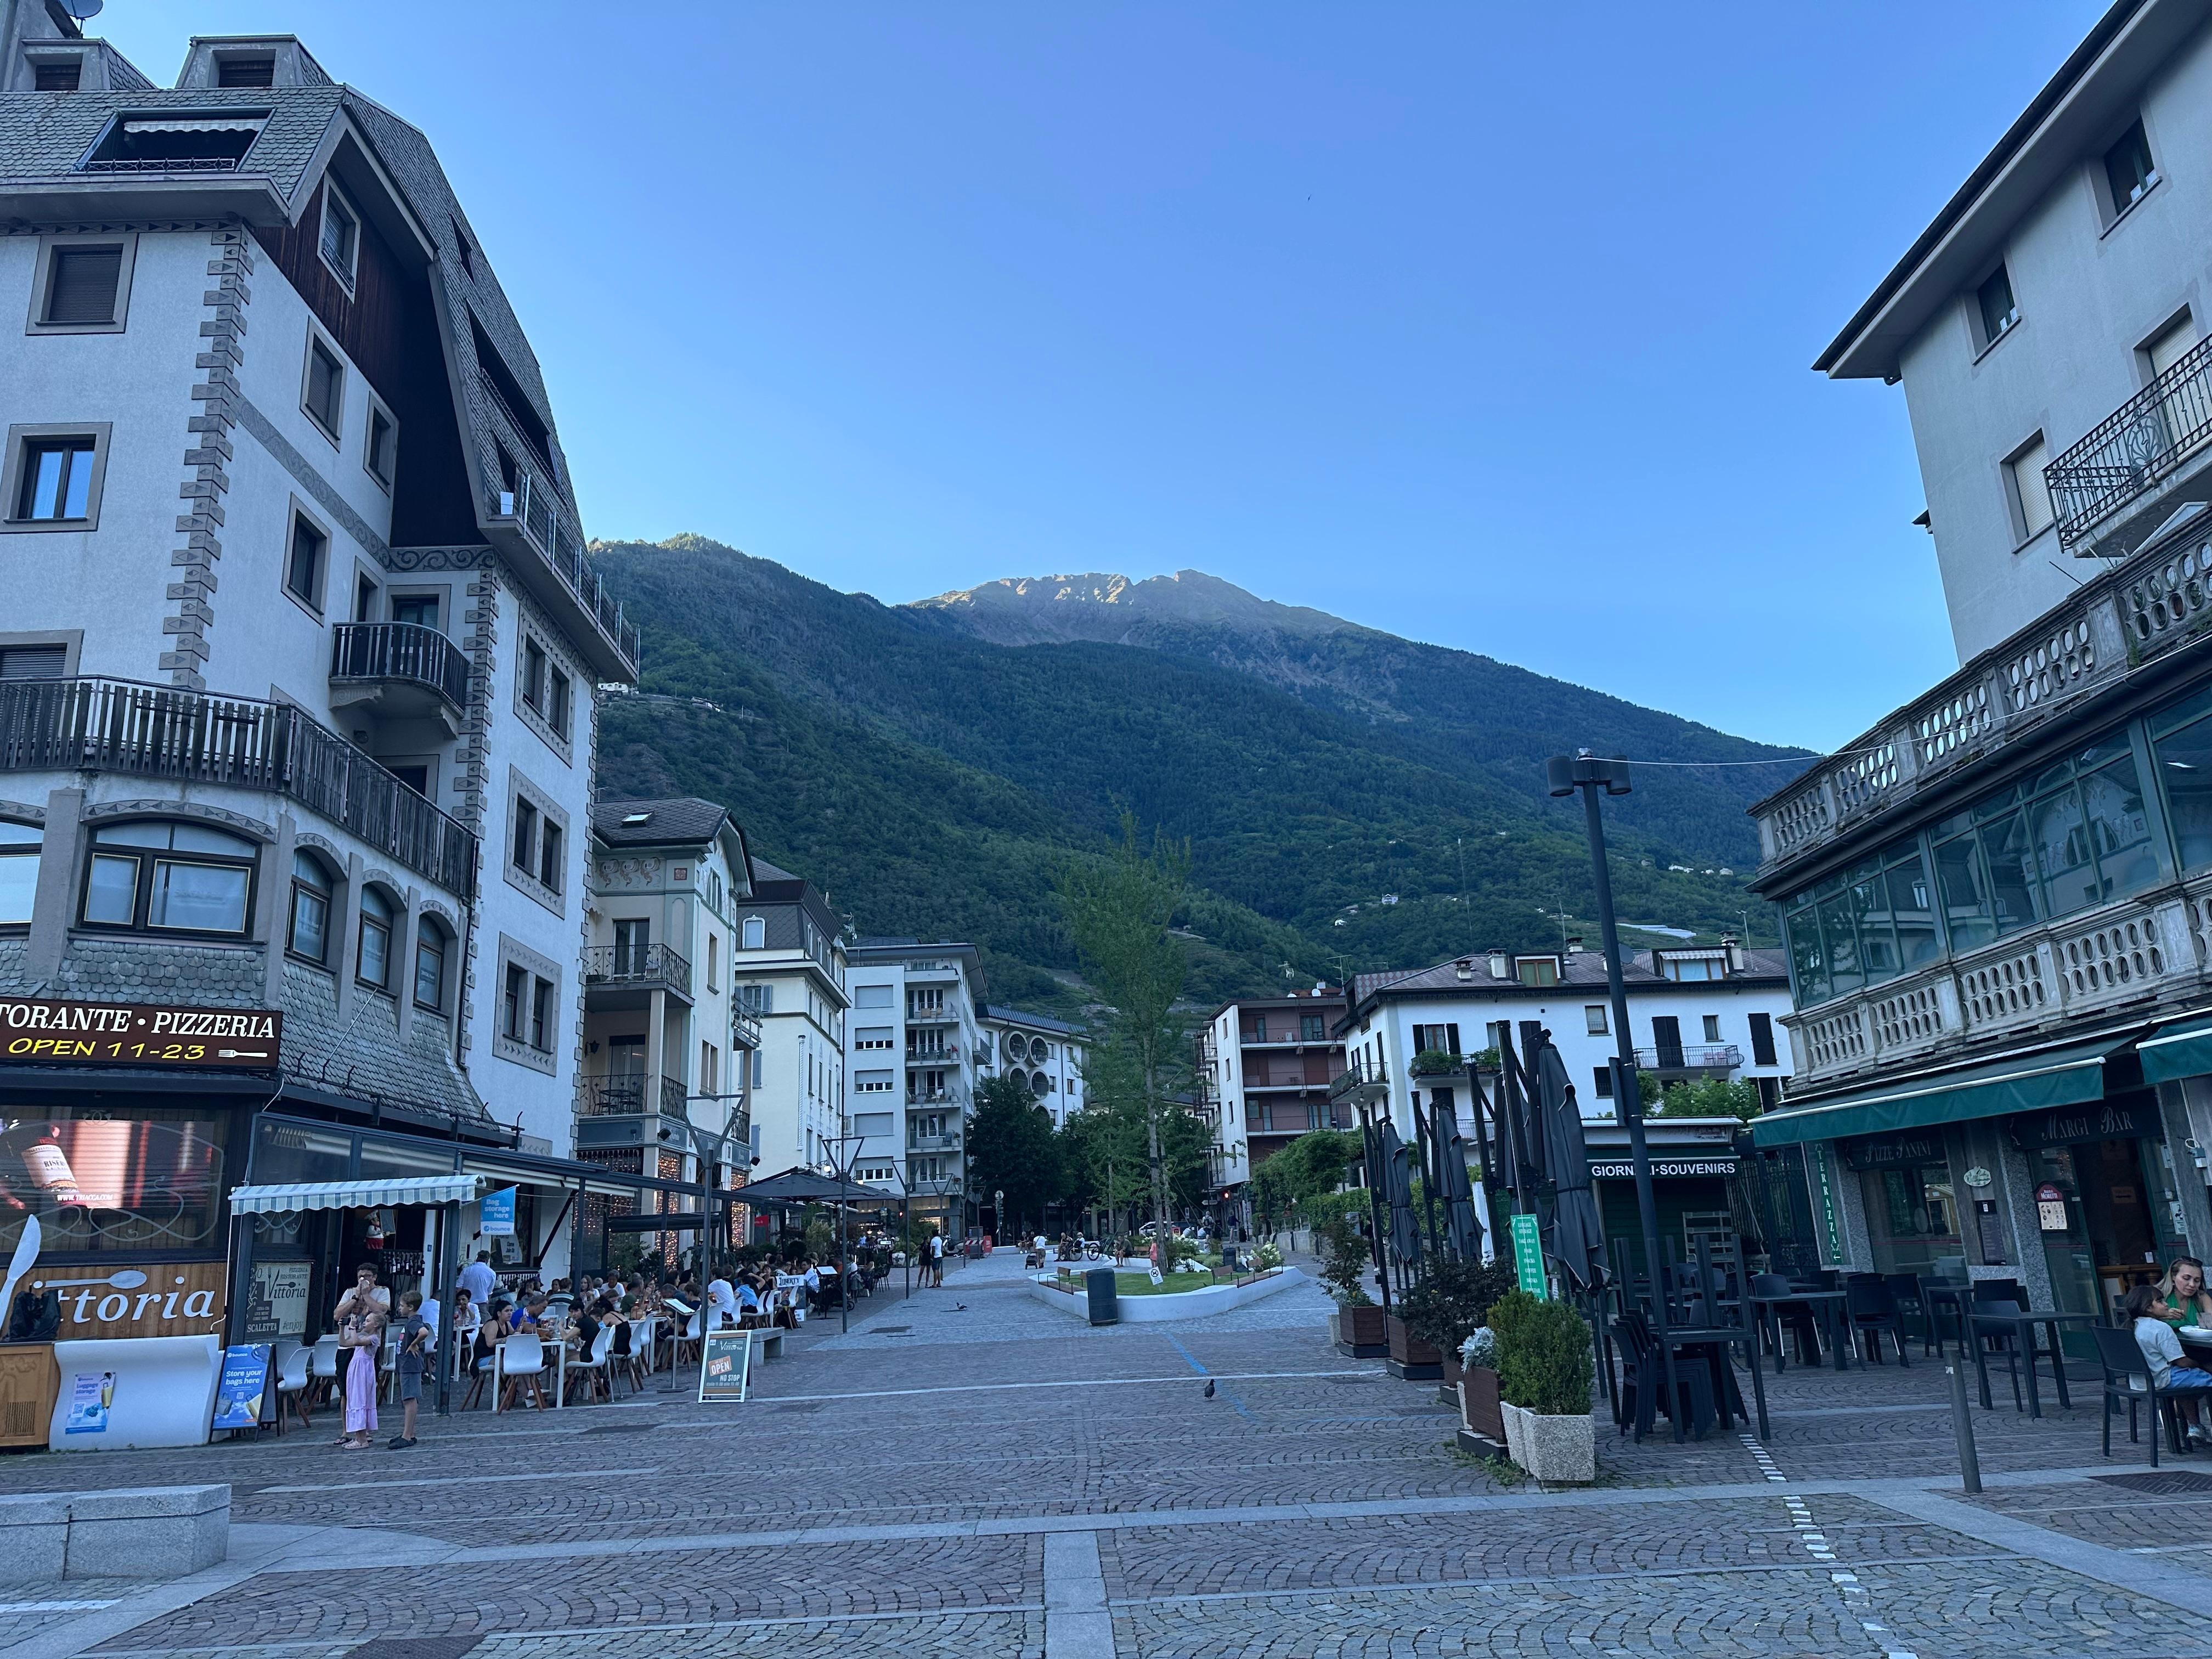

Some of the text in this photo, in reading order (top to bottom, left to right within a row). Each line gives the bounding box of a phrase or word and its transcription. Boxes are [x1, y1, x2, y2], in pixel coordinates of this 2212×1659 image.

[151, 1011, 274, 1039] PIZZERIA
[8, 1037, 97, 1056] OPEN
[1817, 1150, 1836, 1244] TERRAZZA
[267, 1266, 306, 1299] Vittoria
[720, 1340, 743, 1351] Vittoria
[711, 1361, 730, 1375] OPEN
